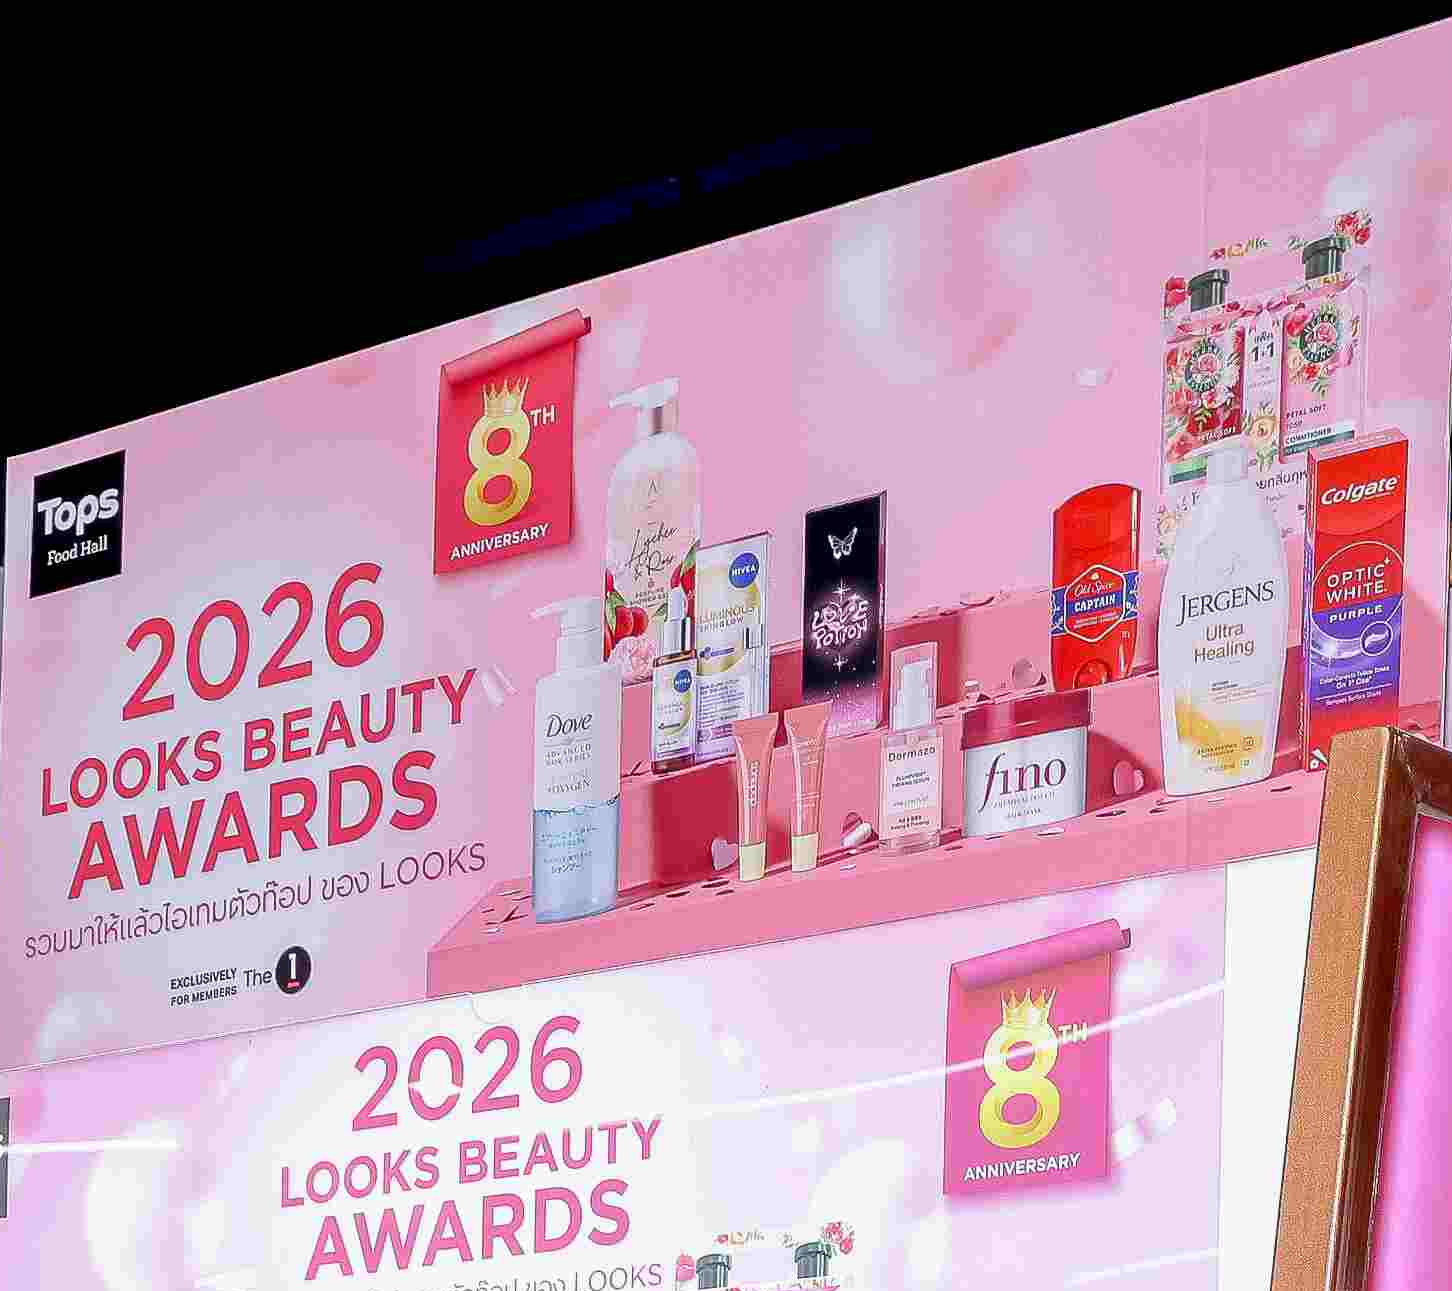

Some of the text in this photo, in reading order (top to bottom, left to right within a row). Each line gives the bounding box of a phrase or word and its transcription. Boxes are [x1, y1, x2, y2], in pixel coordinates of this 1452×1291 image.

[530, 405, 556, 427] TH
[37, 487, 119, 537] Tops
[1321, 476, 1400, 506] Colgate
[47, 535, 108, 567] Food Hall
[449, 522, 549, 561] ANNIVERSARY
[1074, 594, 1116, 612] CAPTAIN
[1176, 580, 1275, 626] JERGENS
[121, 561, 385, 721] 2026
[41, 668, 477, 816] LOOKS BEAUTY
[977, 752, 1068, 814] fino
[68, 749, 440, 899] AWARDS
[320, 869, 371, 902] ของ
[378, 841, 487, 891] LOOKS
[170, 968, 237, 990] EXCLUSIVELY
[170, 984, 237, 1006] FOR MEMBERS
[243, 965, 272, 988] The
[351, 1013, 585, 1132] 2026
[280, 1117, 664, 1209] LOOKS BEAUTY
[963, 1150, 1082, 1182] ANNIVERSARY
[304, 1178, 633, 1281] AWARDS
